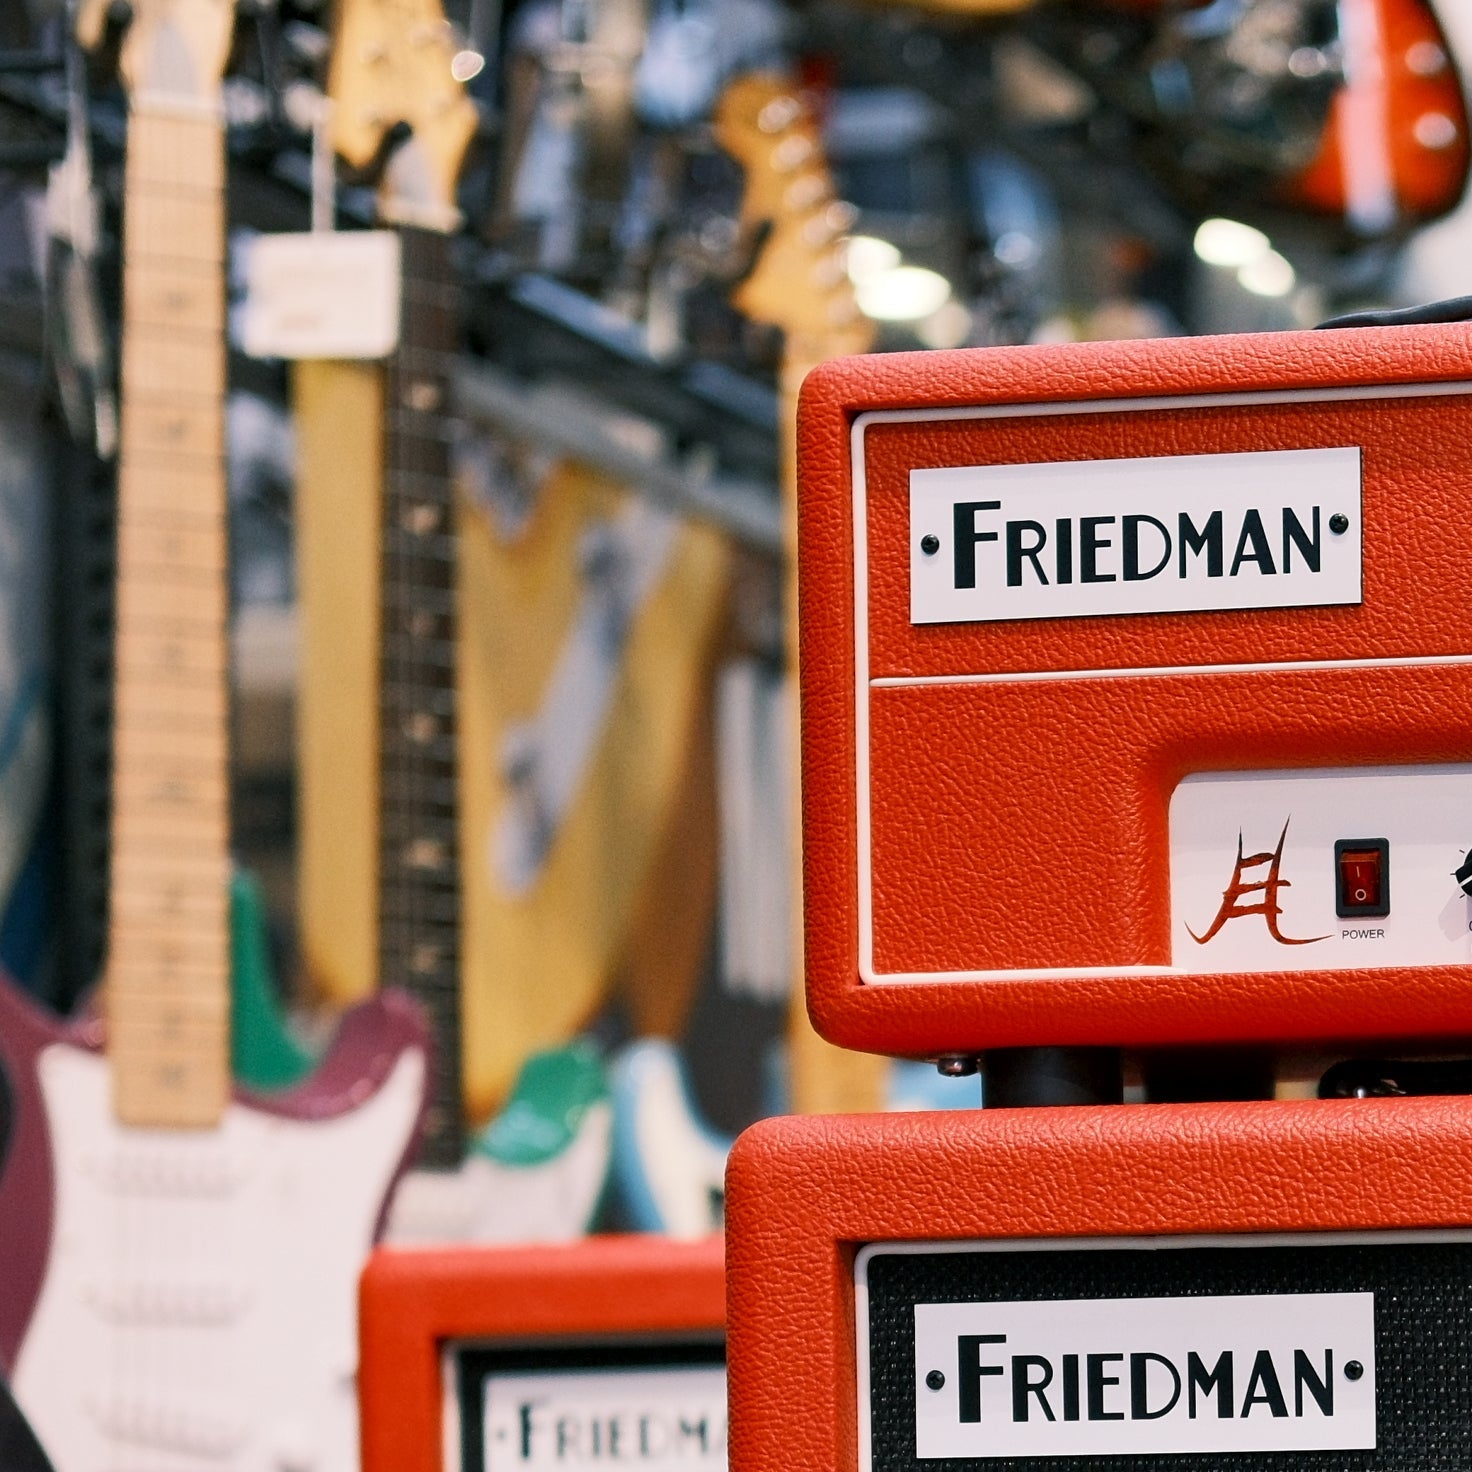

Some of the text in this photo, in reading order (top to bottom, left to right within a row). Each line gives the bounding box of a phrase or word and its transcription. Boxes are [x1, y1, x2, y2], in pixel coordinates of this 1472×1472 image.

[954, 501, 1320, 589] FRIEDMAN
[1341, 928, 1385, 940] POWER
[958, 1335, 1333, 1423] FRIEDMAN
